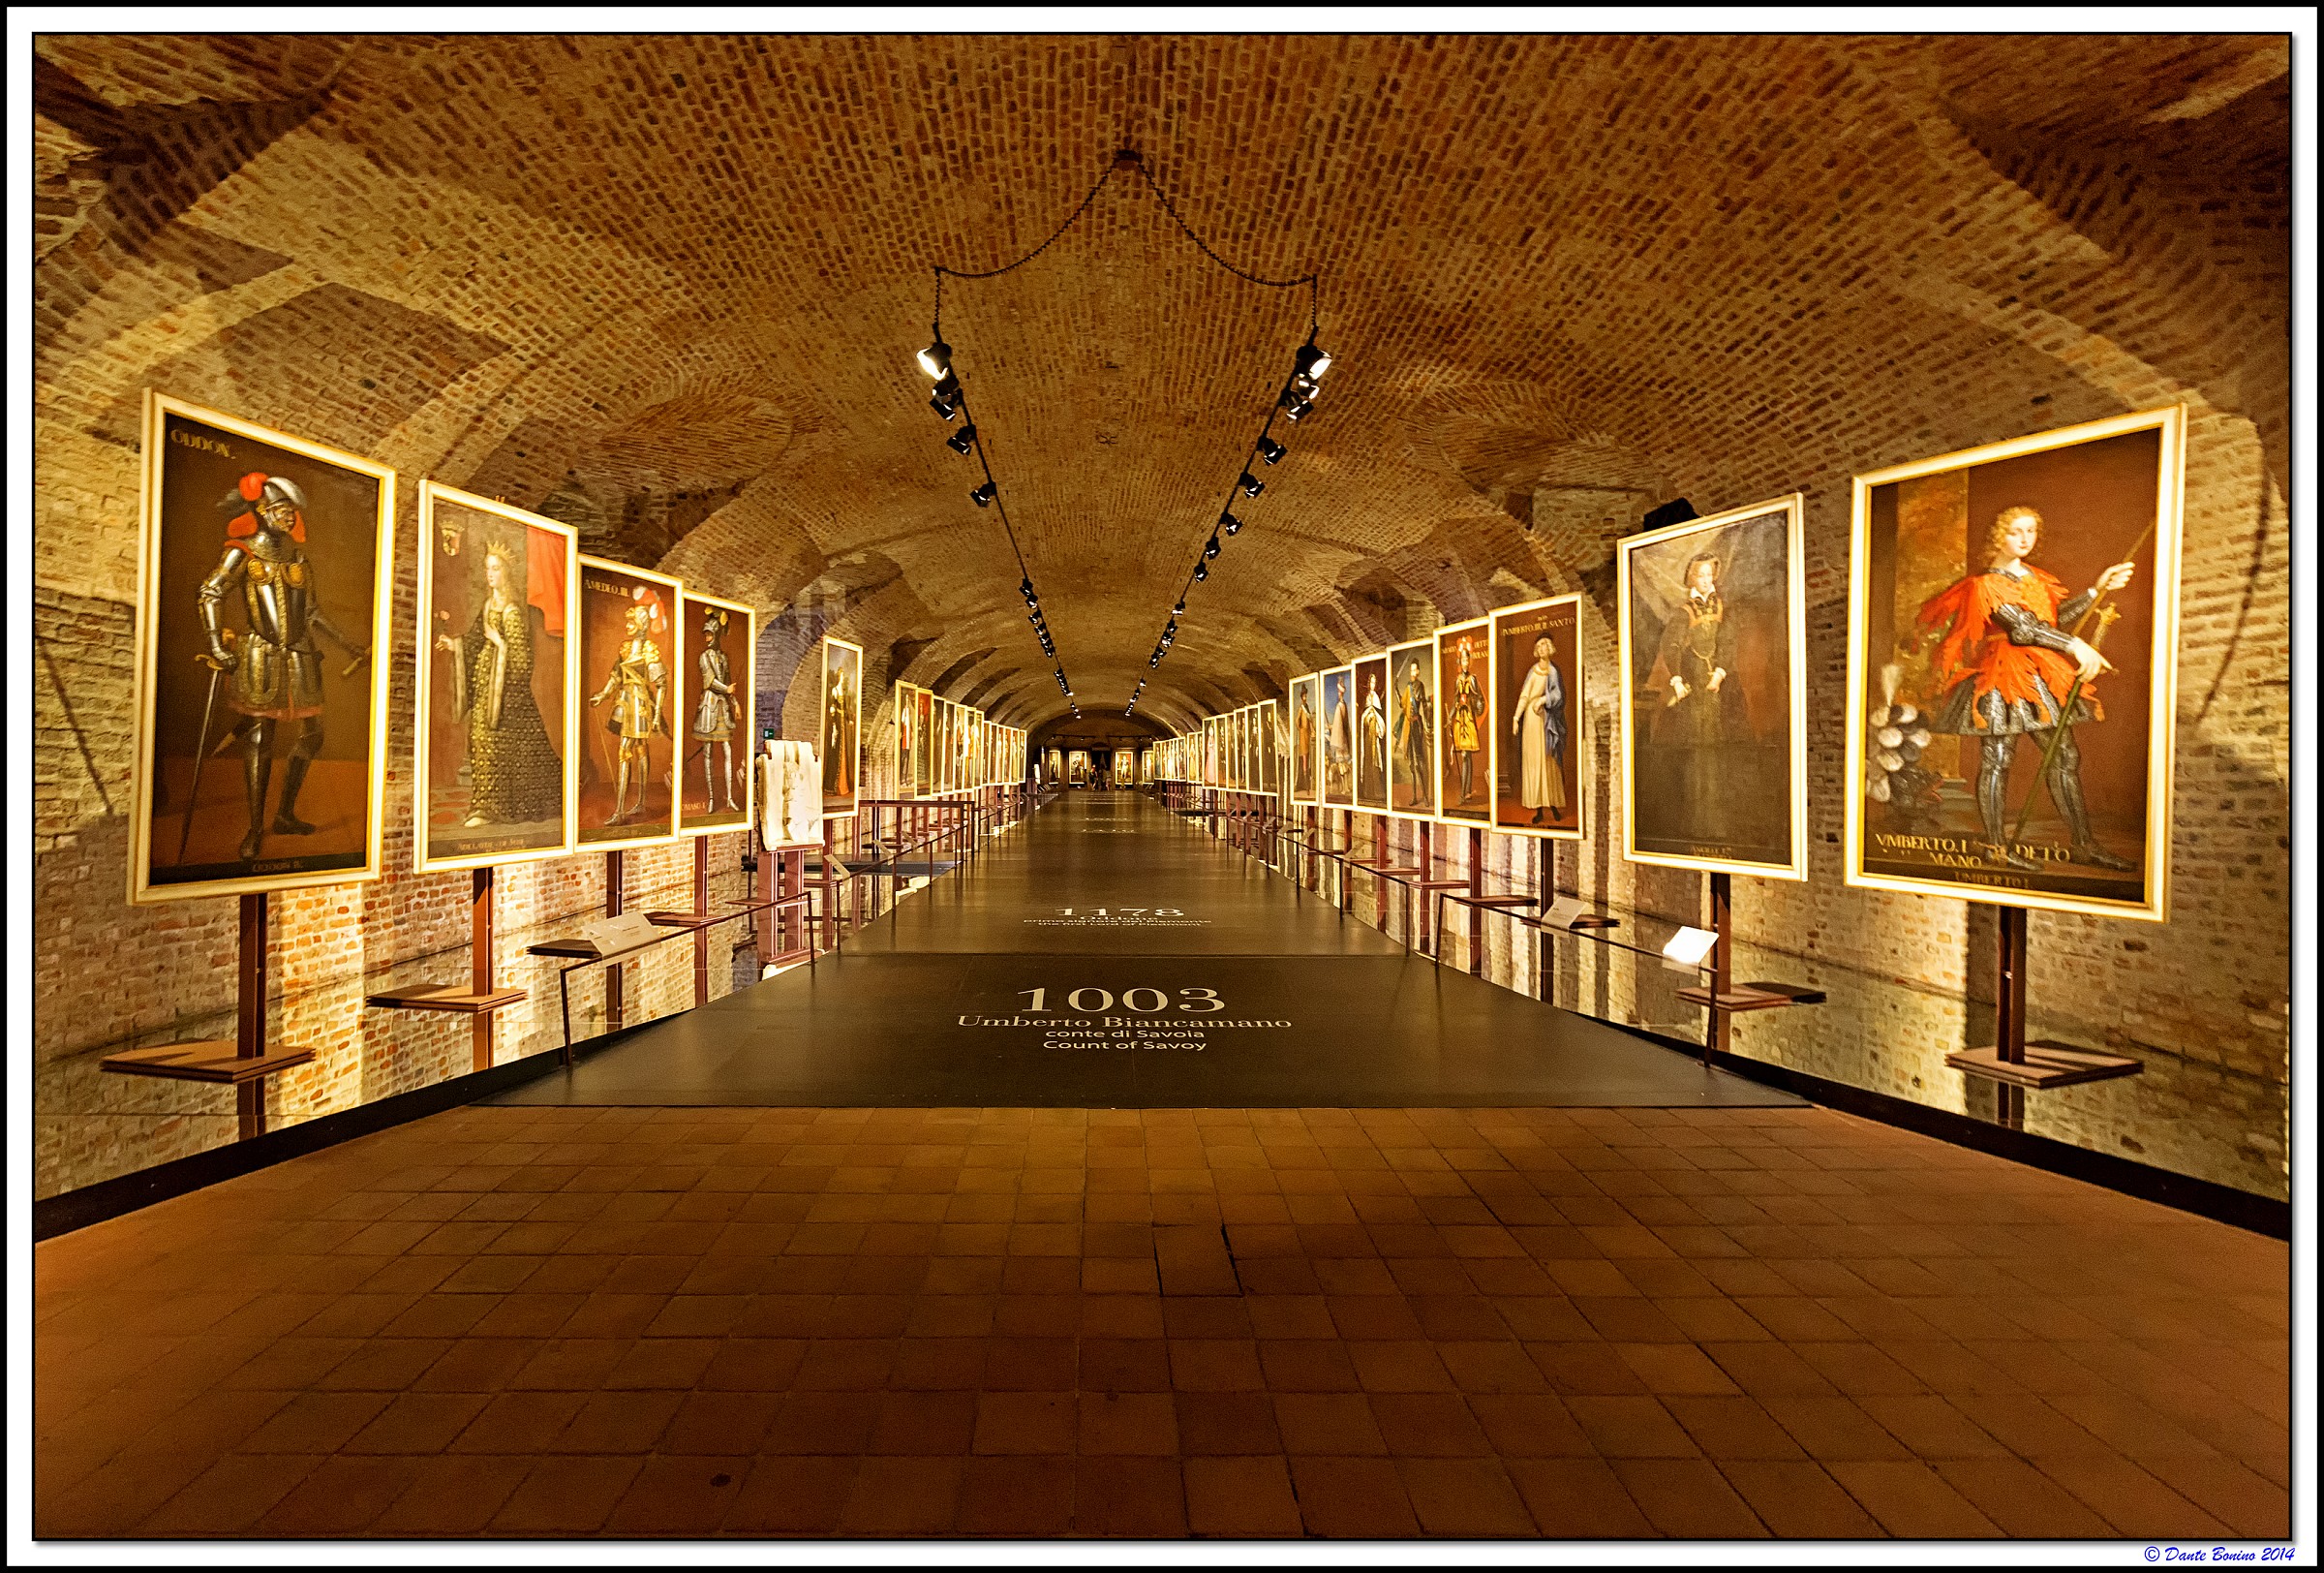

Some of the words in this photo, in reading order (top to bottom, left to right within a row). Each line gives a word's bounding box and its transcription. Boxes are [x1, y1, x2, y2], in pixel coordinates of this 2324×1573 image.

[1930, 851, 1982, 869] MANO
[1055, 908, 1184, 917] 1178
[1017, 987, 1226, 1012] 1003
[958, 1015, 1092, 1029] Umberto
[1102, 1015, 1293, 1029] Biancamano
[1112, 1030, 1131, 1038] di
[1136, 1030, 1206, 1038] Savoia
[1043, 1040, 1110, 1050] Count
[1116, 1040, 1138, 1050] of
[1143, 1040, 1208, 1052] Savoy
